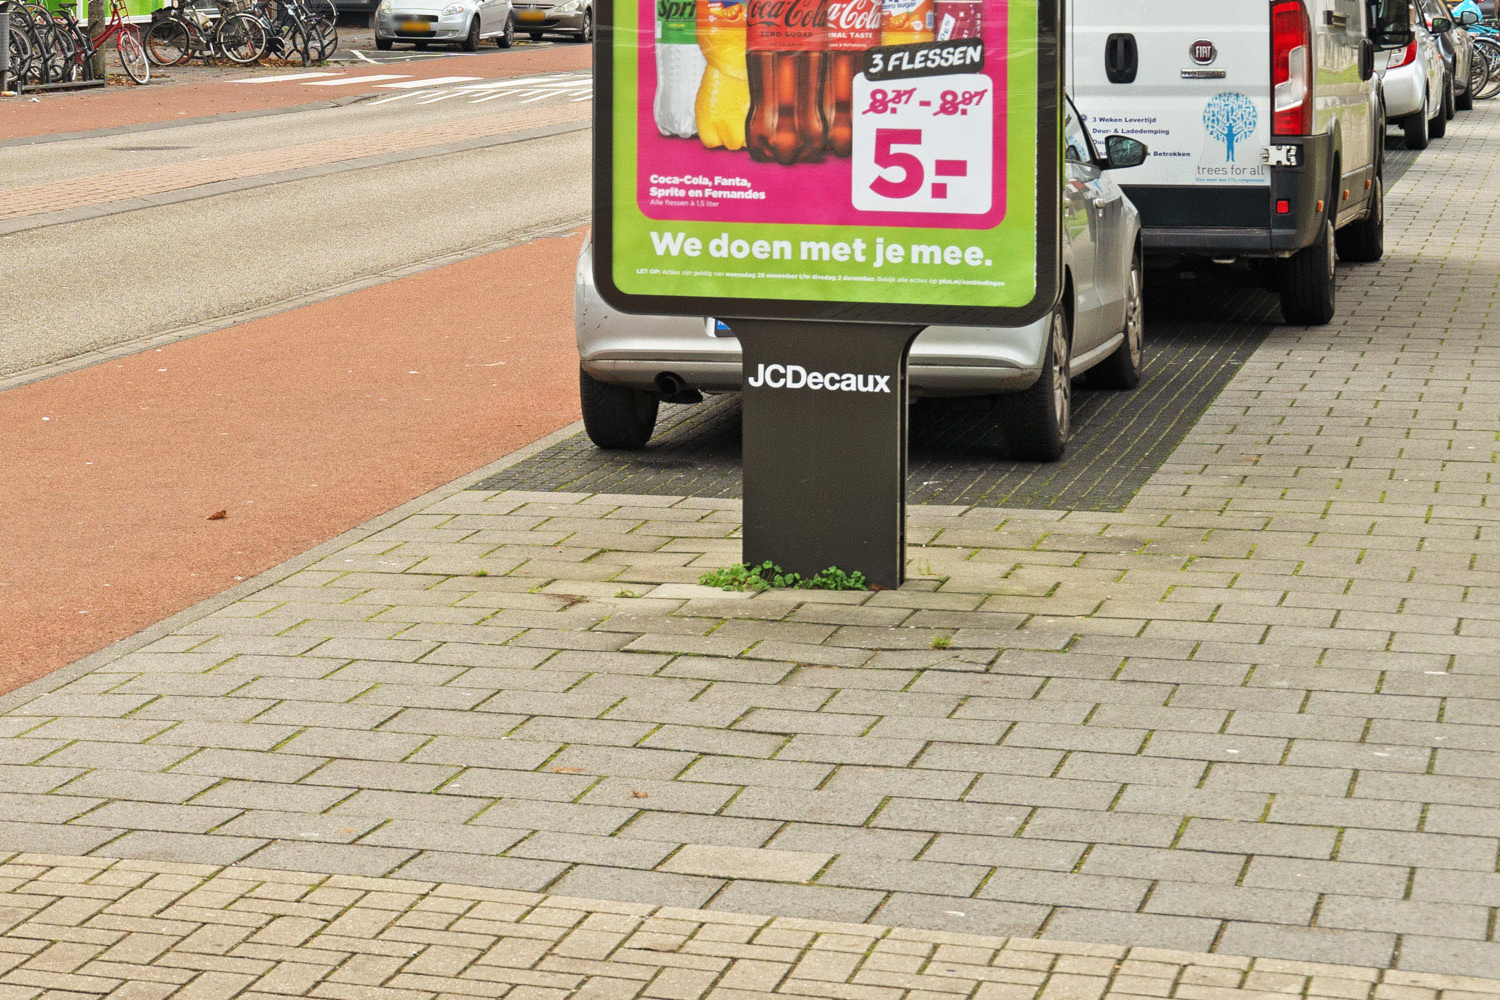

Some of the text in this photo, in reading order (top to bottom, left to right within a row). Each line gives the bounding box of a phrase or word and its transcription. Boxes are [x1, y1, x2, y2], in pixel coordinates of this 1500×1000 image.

[1195, 46, 1212, 58] FIAT
[868, 45, 982, 73] 3 FLESSEN
[1124, 116, 1156, 124] Levertijd
[1121, 128, 1170, 136] Ladedemping
[1197, 164, 1265, 175] trees for all
[650, 174, 752, 188] Coca-Cola, Fanta,
[649, 187, 766, 200] Sprite en Fernandes
[665, 199, 688, 207] flessen
[649, 231, 993, 268] We doen met je mee.
[748, 364, 891, 393] JCDecaux
